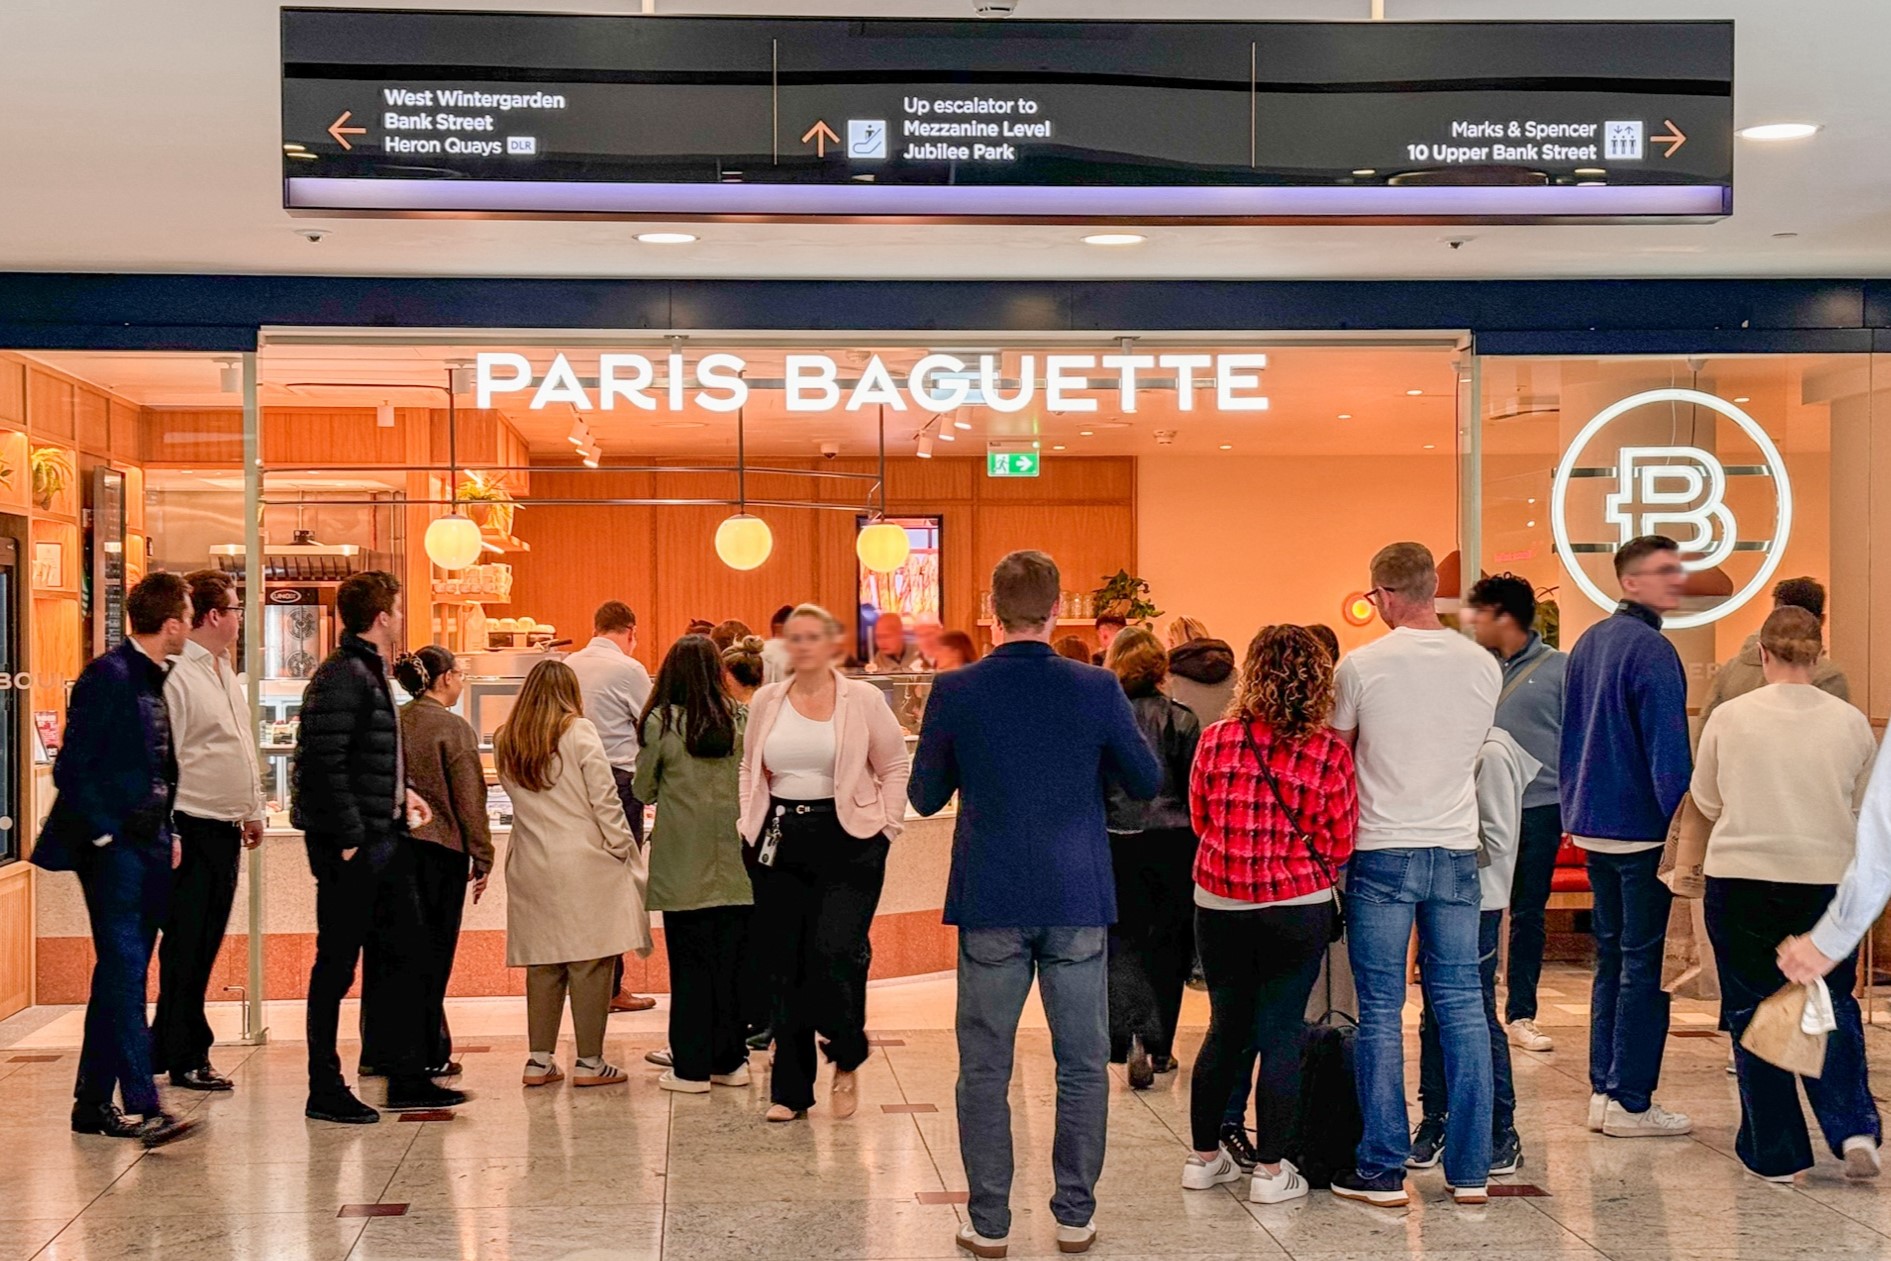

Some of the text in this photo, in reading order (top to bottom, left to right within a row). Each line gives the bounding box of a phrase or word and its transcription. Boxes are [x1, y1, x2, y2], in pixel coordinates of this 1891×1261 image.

[383, 88, 566, 111] West Wintergarden
[903, 96, 1038, 116] Up escalator to
[384, 112, 494, 131] Bank Street
[903, 119, 1051, 138] Mezzanine Level
[1451, 120, 1598, 140] Marks & Spencer
[384, 135, 532, 157] Heron Quays DLR
[903, 142, 1015, 160] Jubilee Park
[1406, 143, 1597, 163] 10 Upper Bank Street
[475, 352, 1270, 413] PARIS BAGUETTE
